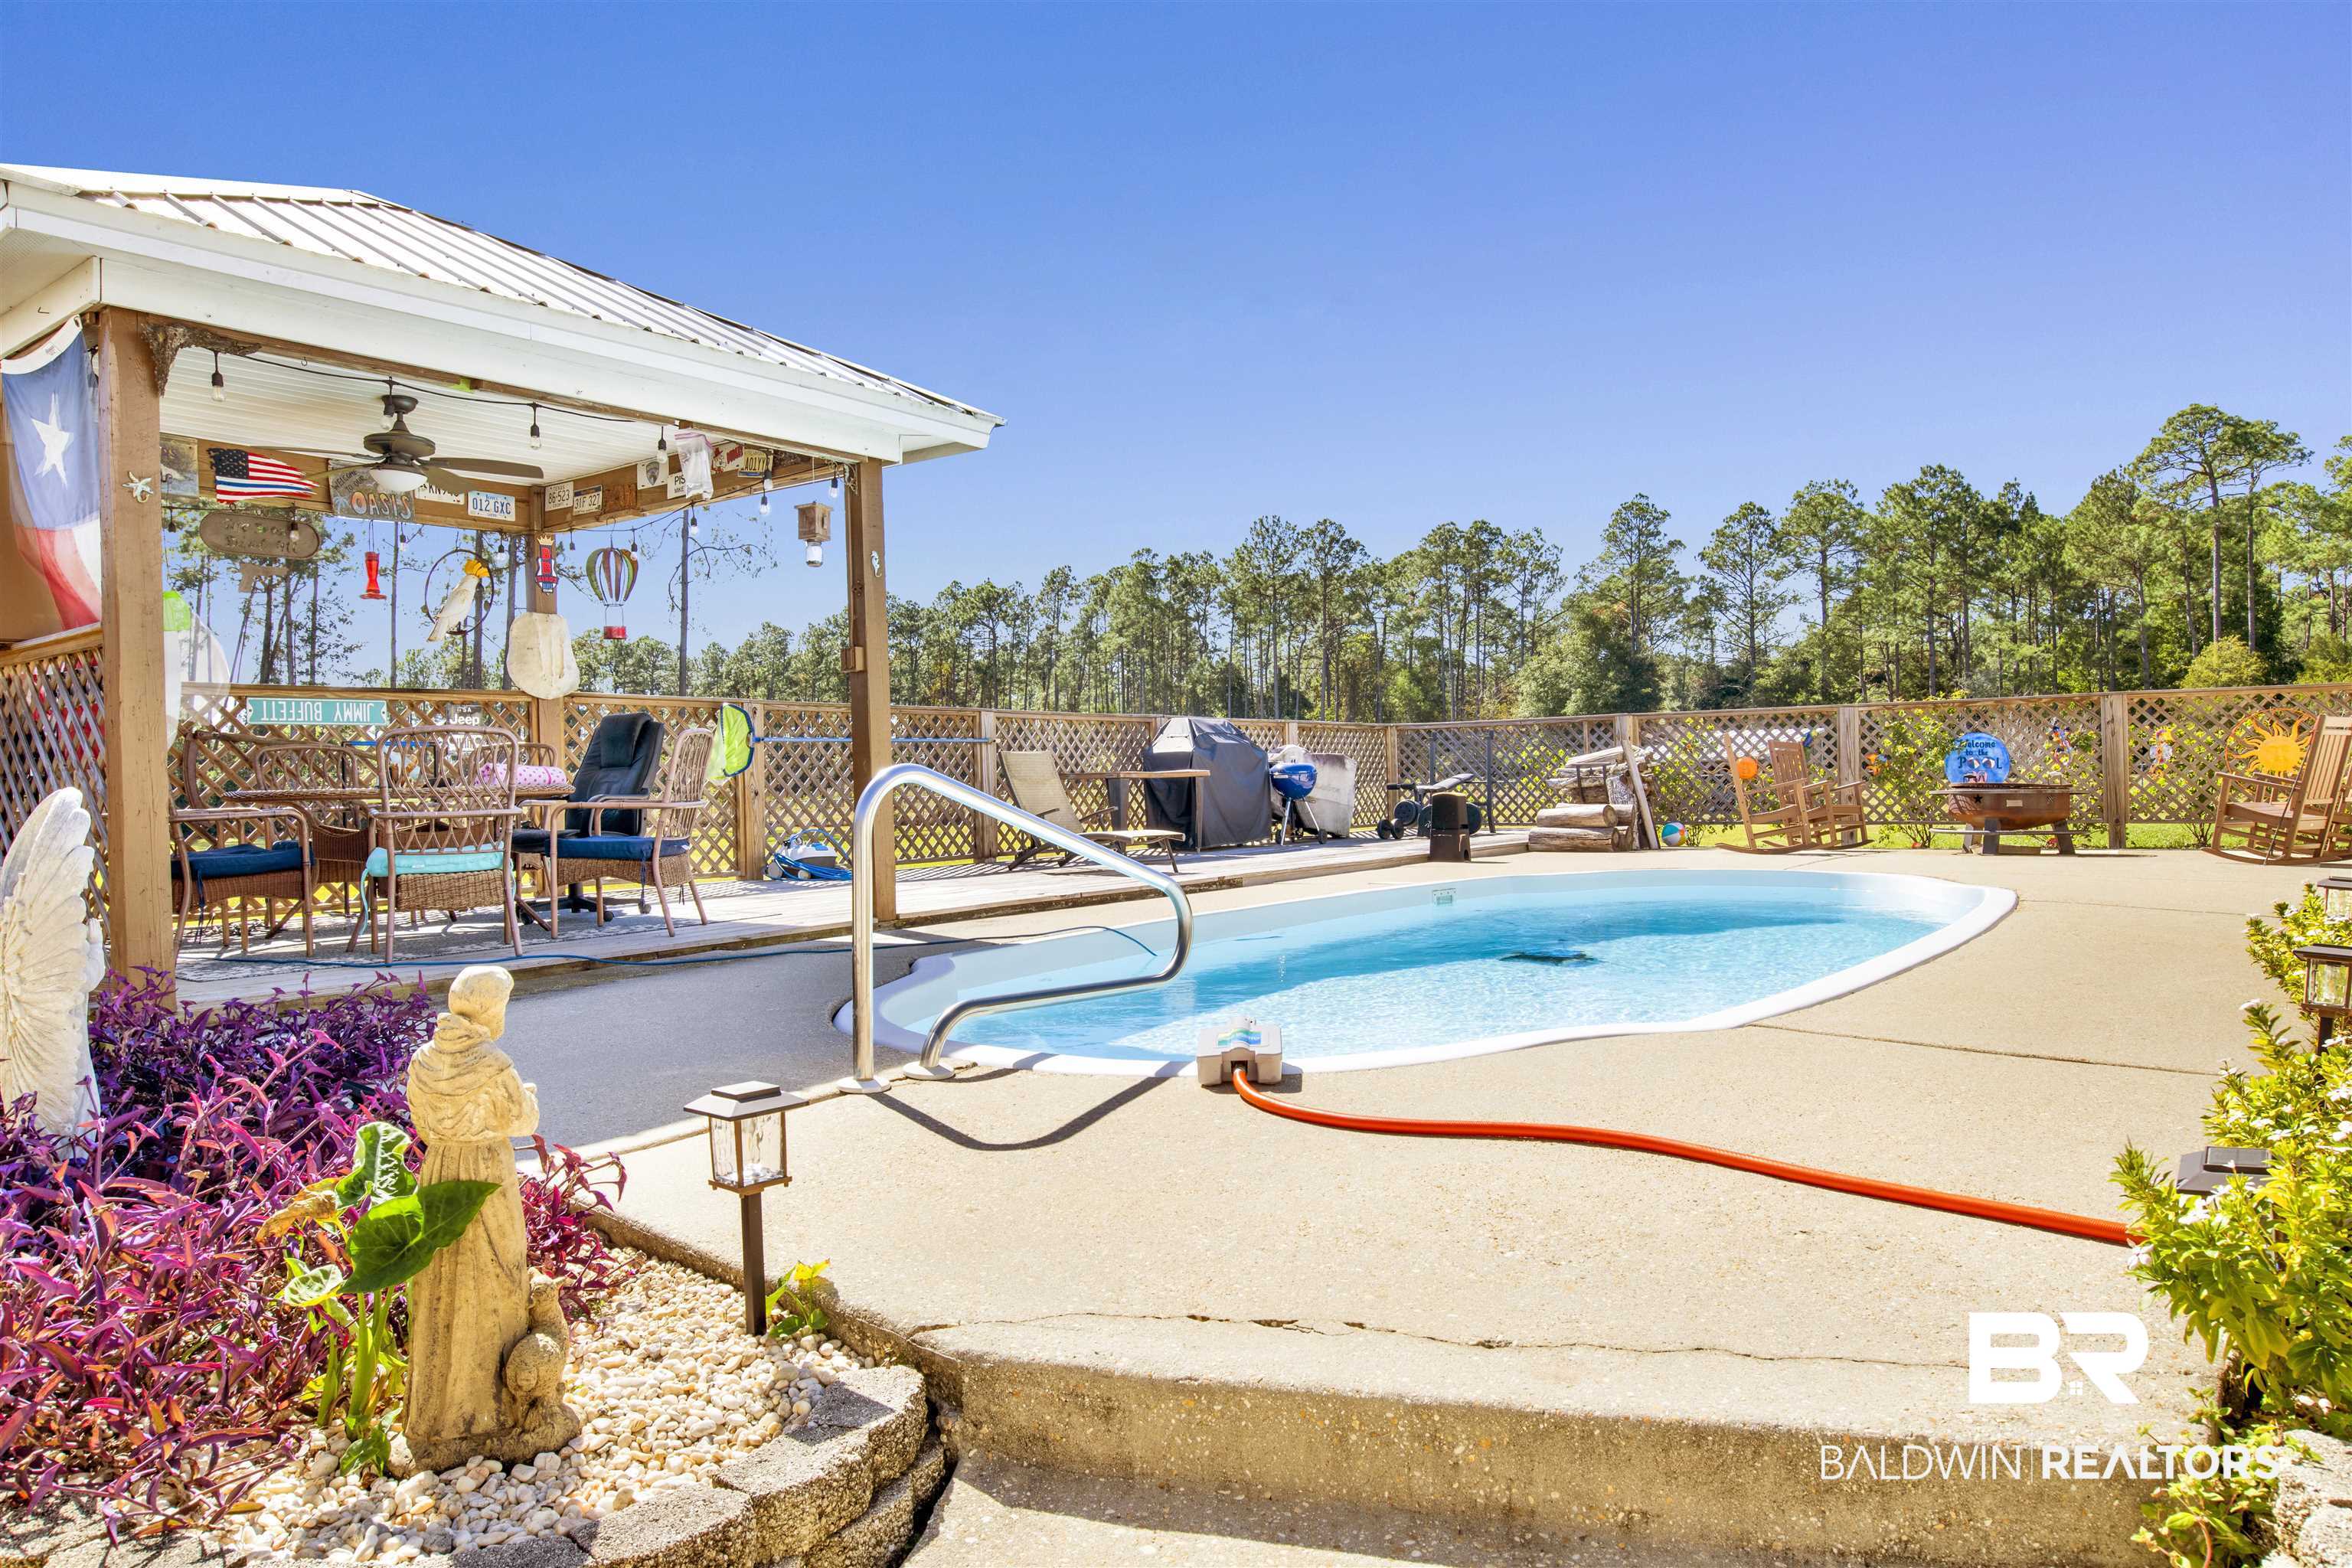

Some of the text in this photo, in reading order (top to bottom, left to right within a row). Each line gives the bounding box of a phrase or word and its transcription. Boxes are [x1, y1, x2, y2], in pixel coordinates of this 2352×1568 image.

[351, 491, 412, 520] OASIS
[472, 497, 511, 515] 012 GXC
[589, 493, 600, 506] 327
[261, 701, 374, 722] JIMMY BUFFETT
[449, 714, 480, 727] Jeep
